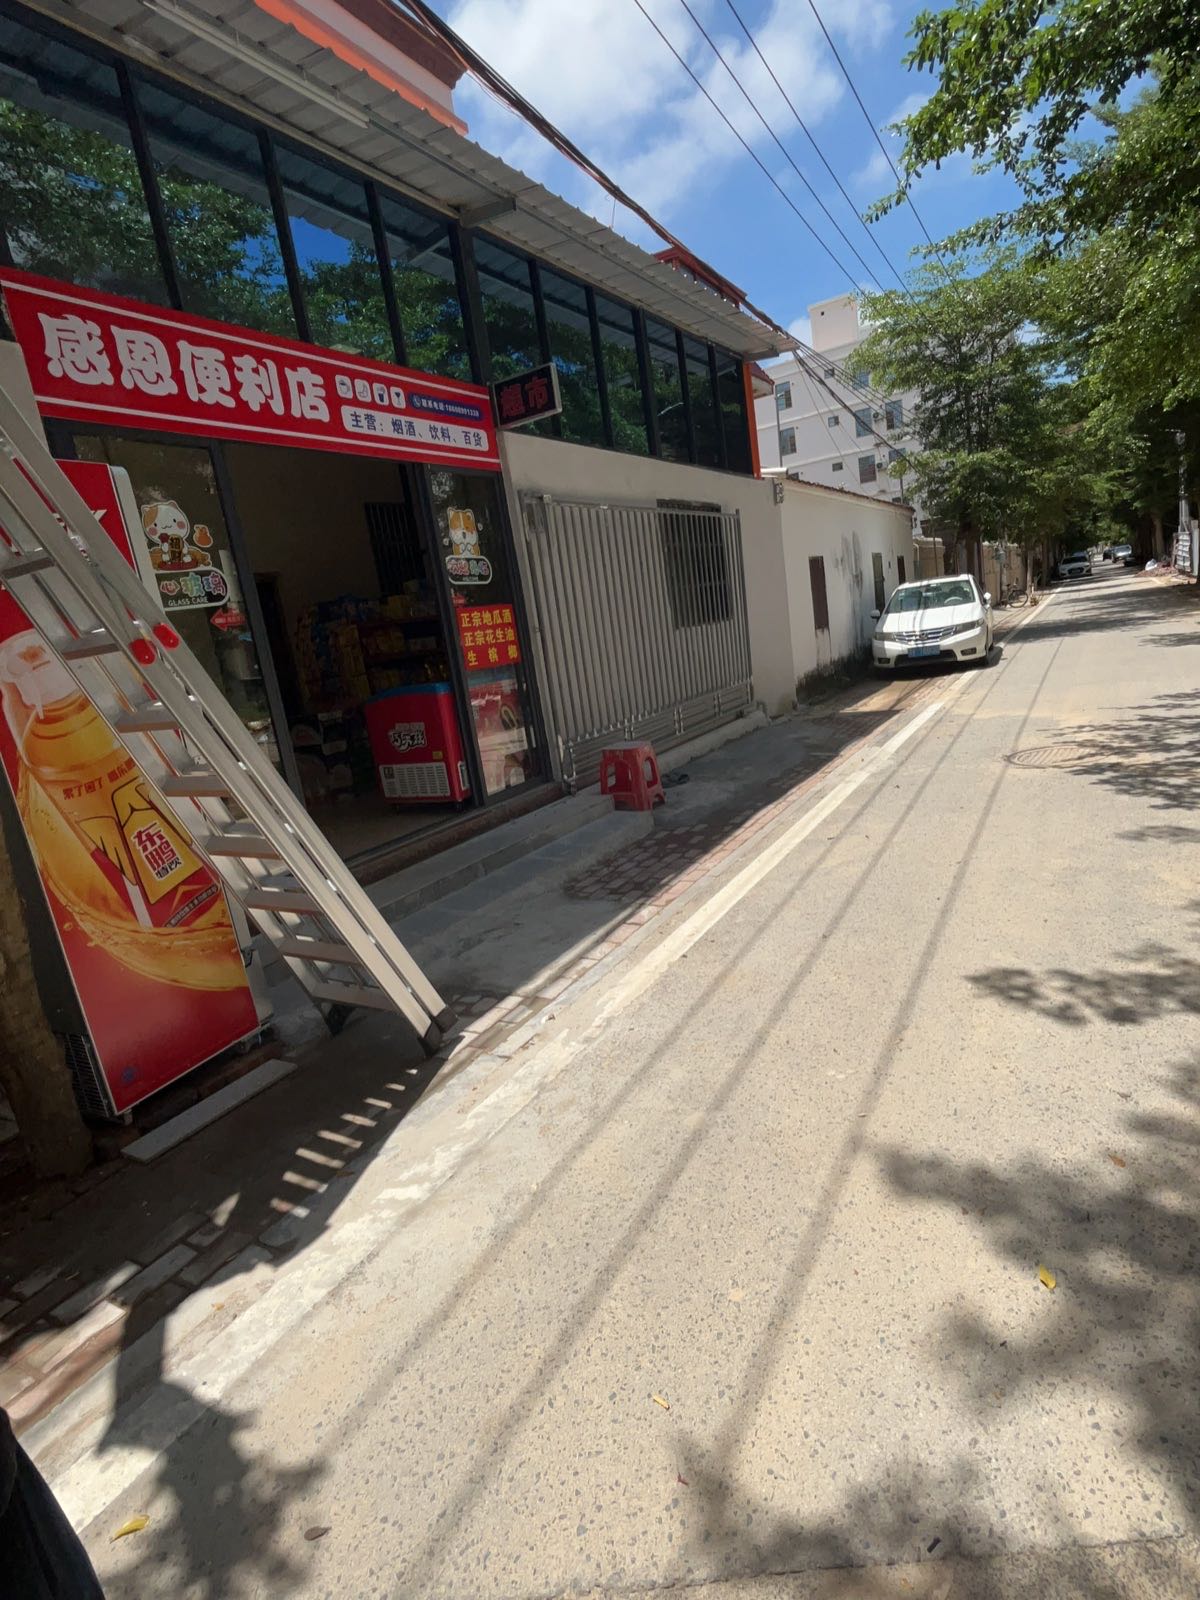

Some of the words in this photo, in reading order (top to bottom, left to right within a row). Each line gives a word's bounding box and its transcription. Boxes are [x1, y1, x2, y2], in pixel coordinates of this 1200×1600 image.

[37, 312, 330, 424] 感恩便利店
[500, 376, 549, 418] 超市
[168, 597, 191, 607] GLASS
[191, 596, 209, 604] CARE
[460, 608, 513, 628] 正宗地瓜酒
[464, 627, 515, 647] 正宗花生油
[63, 776, 103, 800] 累了困了
